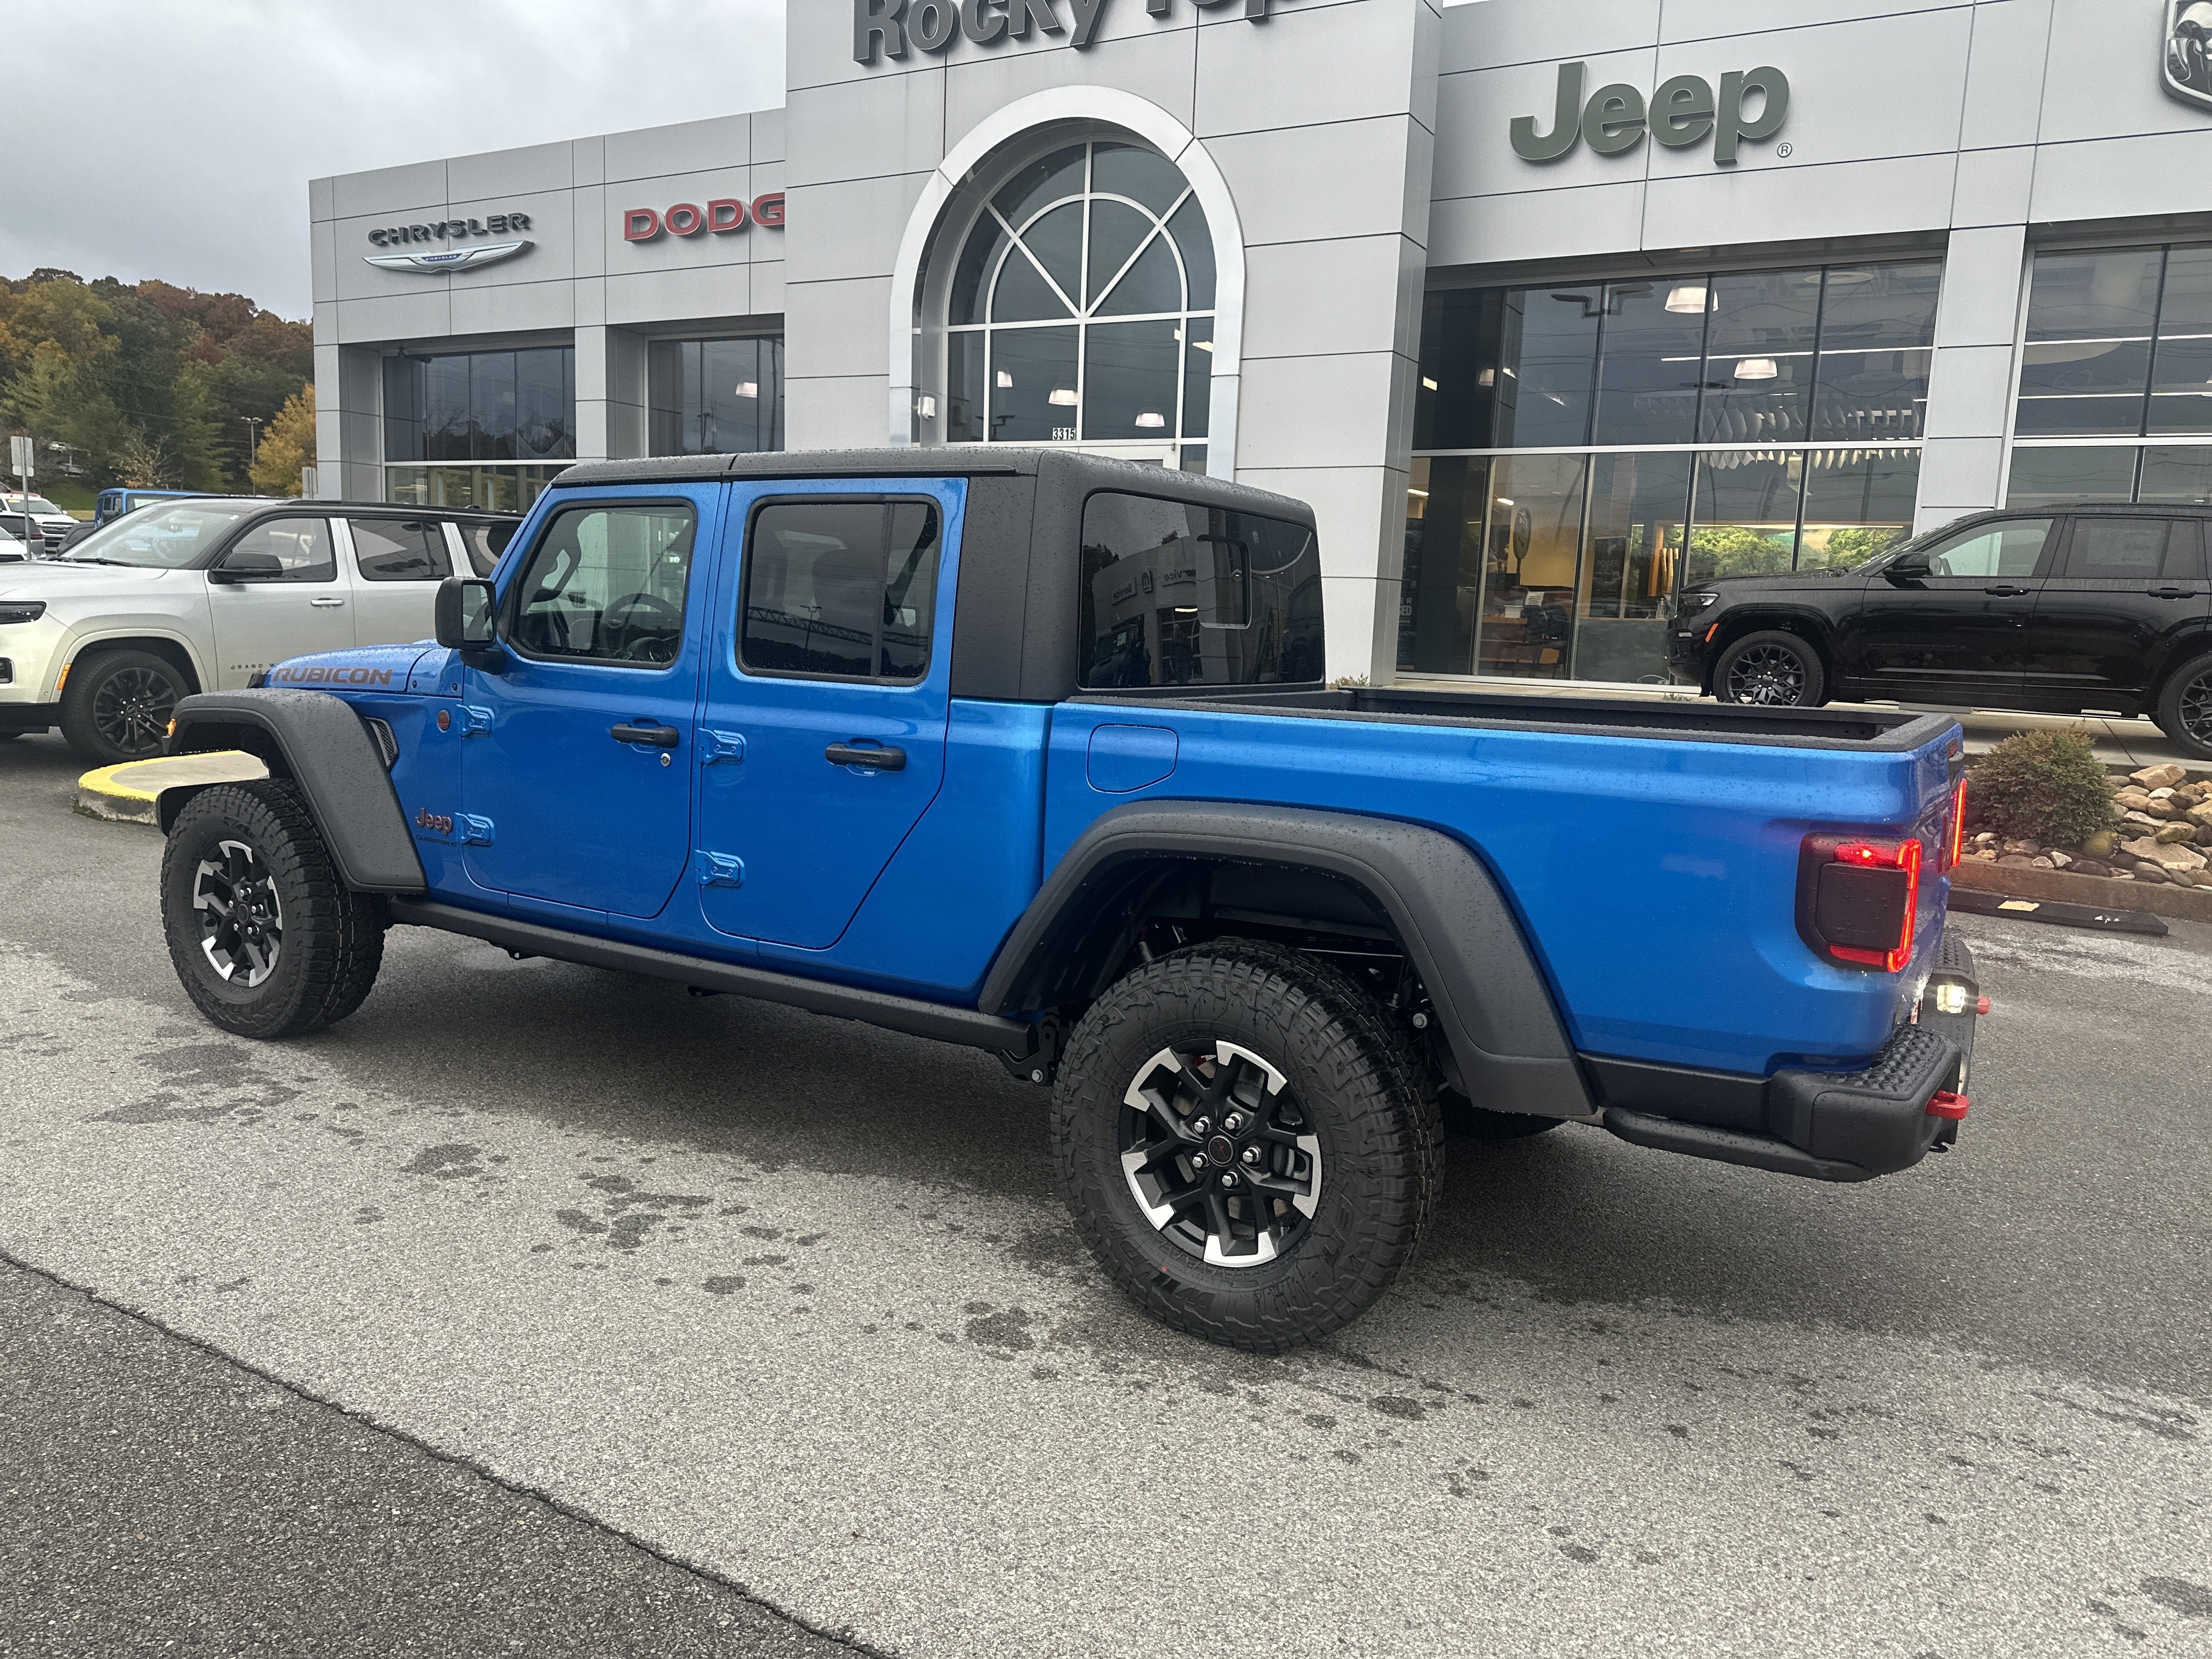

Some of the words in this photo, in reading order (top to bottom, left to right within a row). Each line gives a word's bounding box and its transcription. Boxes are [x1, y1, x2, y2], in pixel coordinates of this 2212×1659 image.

[1510, 61, 1790, 164] Jeep
[367, 212, 528, 245] CHRYSLER
[1053, 428, 1075, 439] 3315
[272, 667, 395, 686] RUBICON
[415, 807, 453, 837] Jeep
